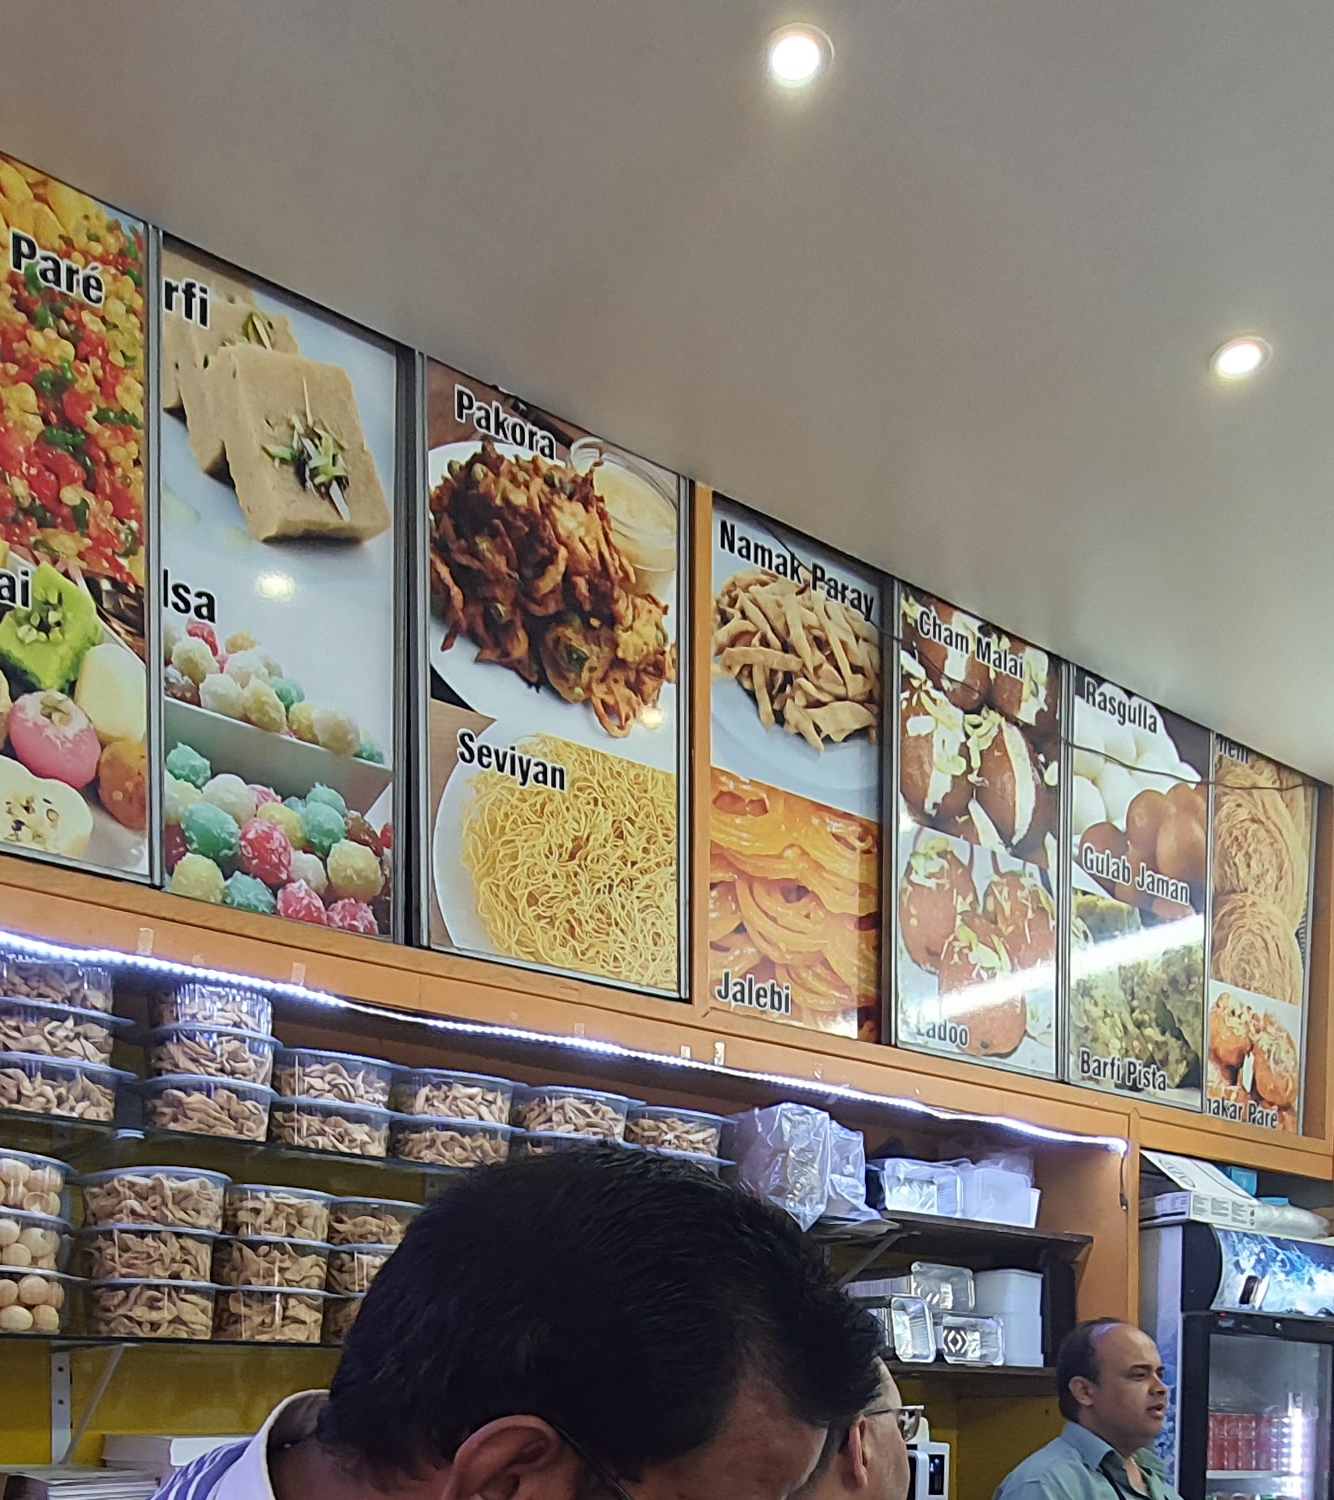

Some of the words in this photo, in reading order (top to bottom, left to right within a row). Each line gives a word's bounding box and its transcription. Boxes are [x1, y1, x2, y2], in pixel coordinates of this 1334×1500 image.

[10, 230, 105, 307] Paré
[455, 386, 556, 460] Pakora
[719, 518, 803, 585] Namak
[811, 561, 875, 622] Paray
[918, 610, 970, 651] Cham
[976, 637, 1025, 679] Malai
[1085, 679, 1158, 735] Rasgulla
[458, 733, 567, 791] Seviyan
[1083, 844, 1132, 886] Gulab
[1136, 863, 1190, 905] Jaman
[715, 970, 793, 1015] Jalebi
[1080, 1050, 1121, 1082] Barfi
[1127, 1060, 1167, 1092] Pista
[1248, 1102, 1279, 1130] Paré
